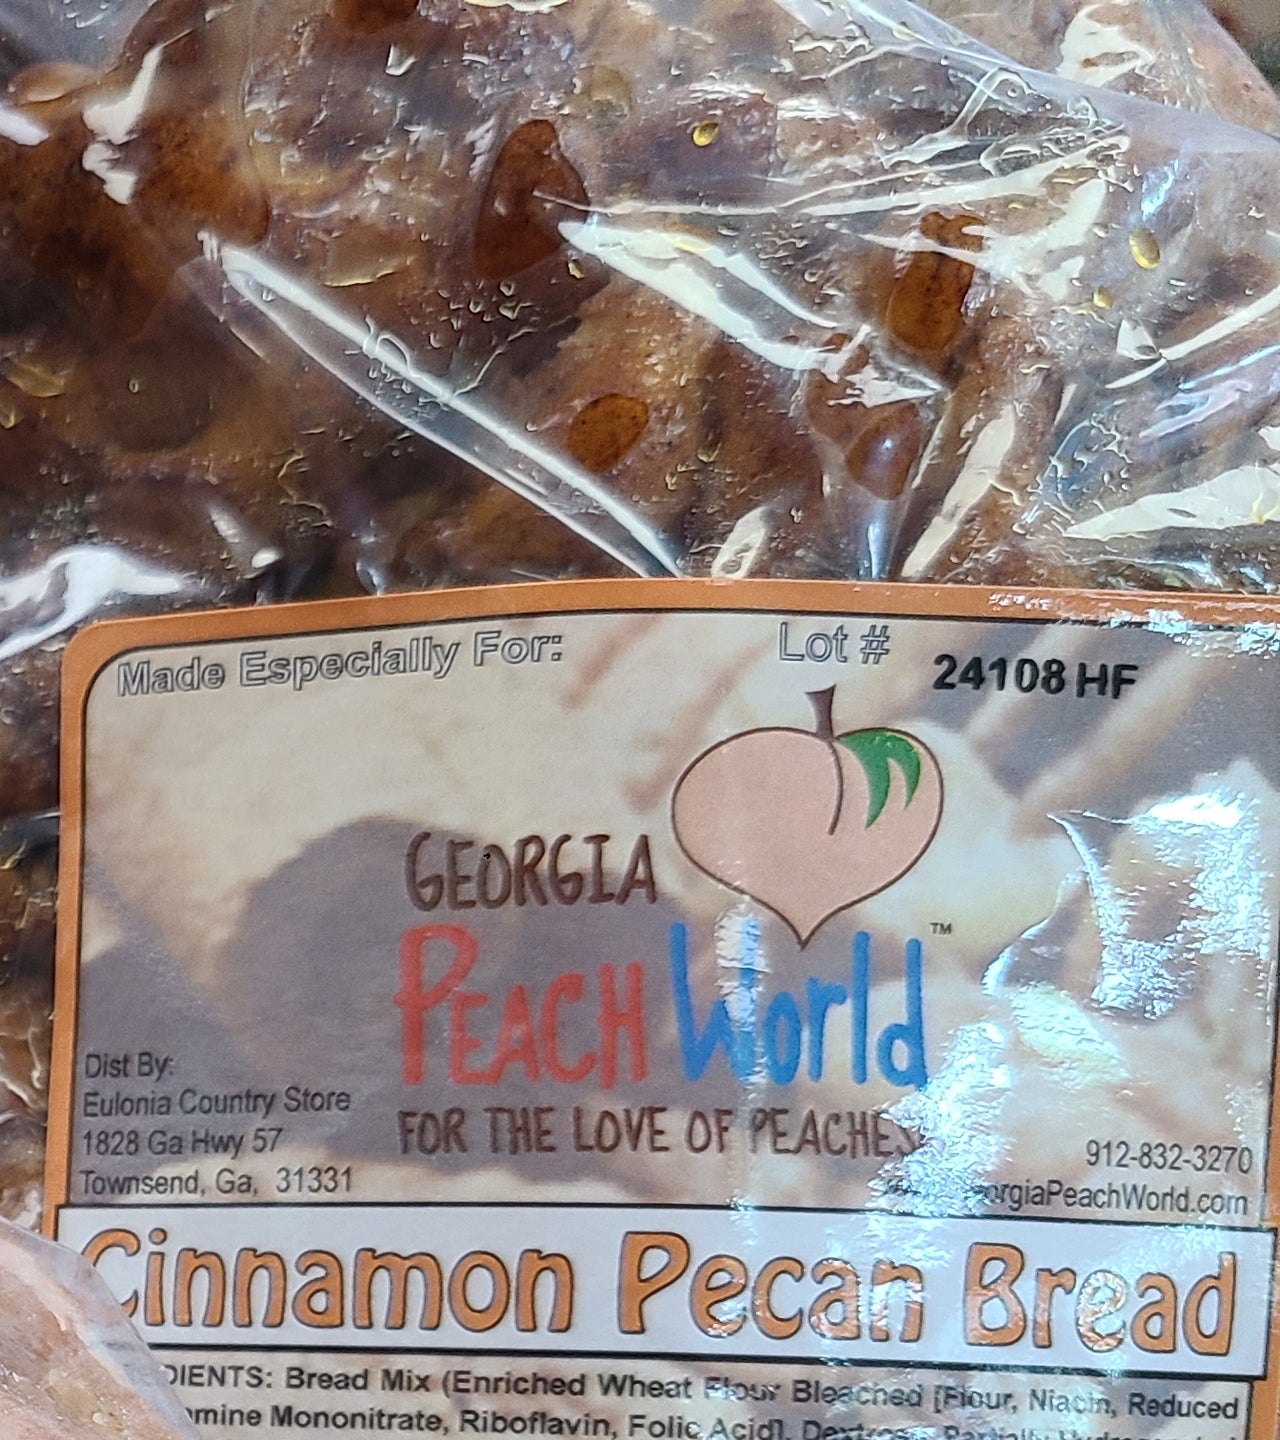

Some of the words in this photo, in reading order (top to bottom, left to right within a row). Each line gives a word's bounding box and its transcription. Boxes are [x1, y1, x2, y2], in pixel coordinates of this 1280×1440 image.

[117, 657, 224, 696] Made
[240, 638, 460, 688] Especially
[473, 628, 563, 669] For:
[778, 622, 846, 663] Lot
[856, 624, 892, 665] #
[931, 654, 1065, 698] 24108
[1077, 661, 1138, 701] HF
[406, 832, 658, 911] GEORGIA
[396, 923, 646, 1089] PEACH
[668, 922, 927, 1089] World
[84, 1052, 129, 1078] Dist
[137, 1052, 173, 1081] By:
[83, 1092, 171, 1118] Eulonia
[179, 1088, 276, 1118] Country
[283, 1085, 351, 1112] Store
[83, 1131, 139, 1156] 1828
[148, 1130, 183, 1155] Ga
[191, 1129, 244, 1159] Hwy
[252, 1128, 283, 1152] 57
[398, 1108, 468, 1157] FOR
[486, 1106, 557, 1154] THE
[573, 1106, 670, 1153] LOVE
[685, 1106, 732, 1153] OF
[750, 1107, 926, 1159] PEACHES
[1085, 1140, 1253, 1174] 912-832-3270
[79, 1170, 206, 1196] Townsend,
[215, 1169, 258, 1196] Ga,
[276, 1167, 353, 1193] 31331
[619, 1231, 923, 1345] Pecan
[965, 1241, 1236, 1360] Bread
